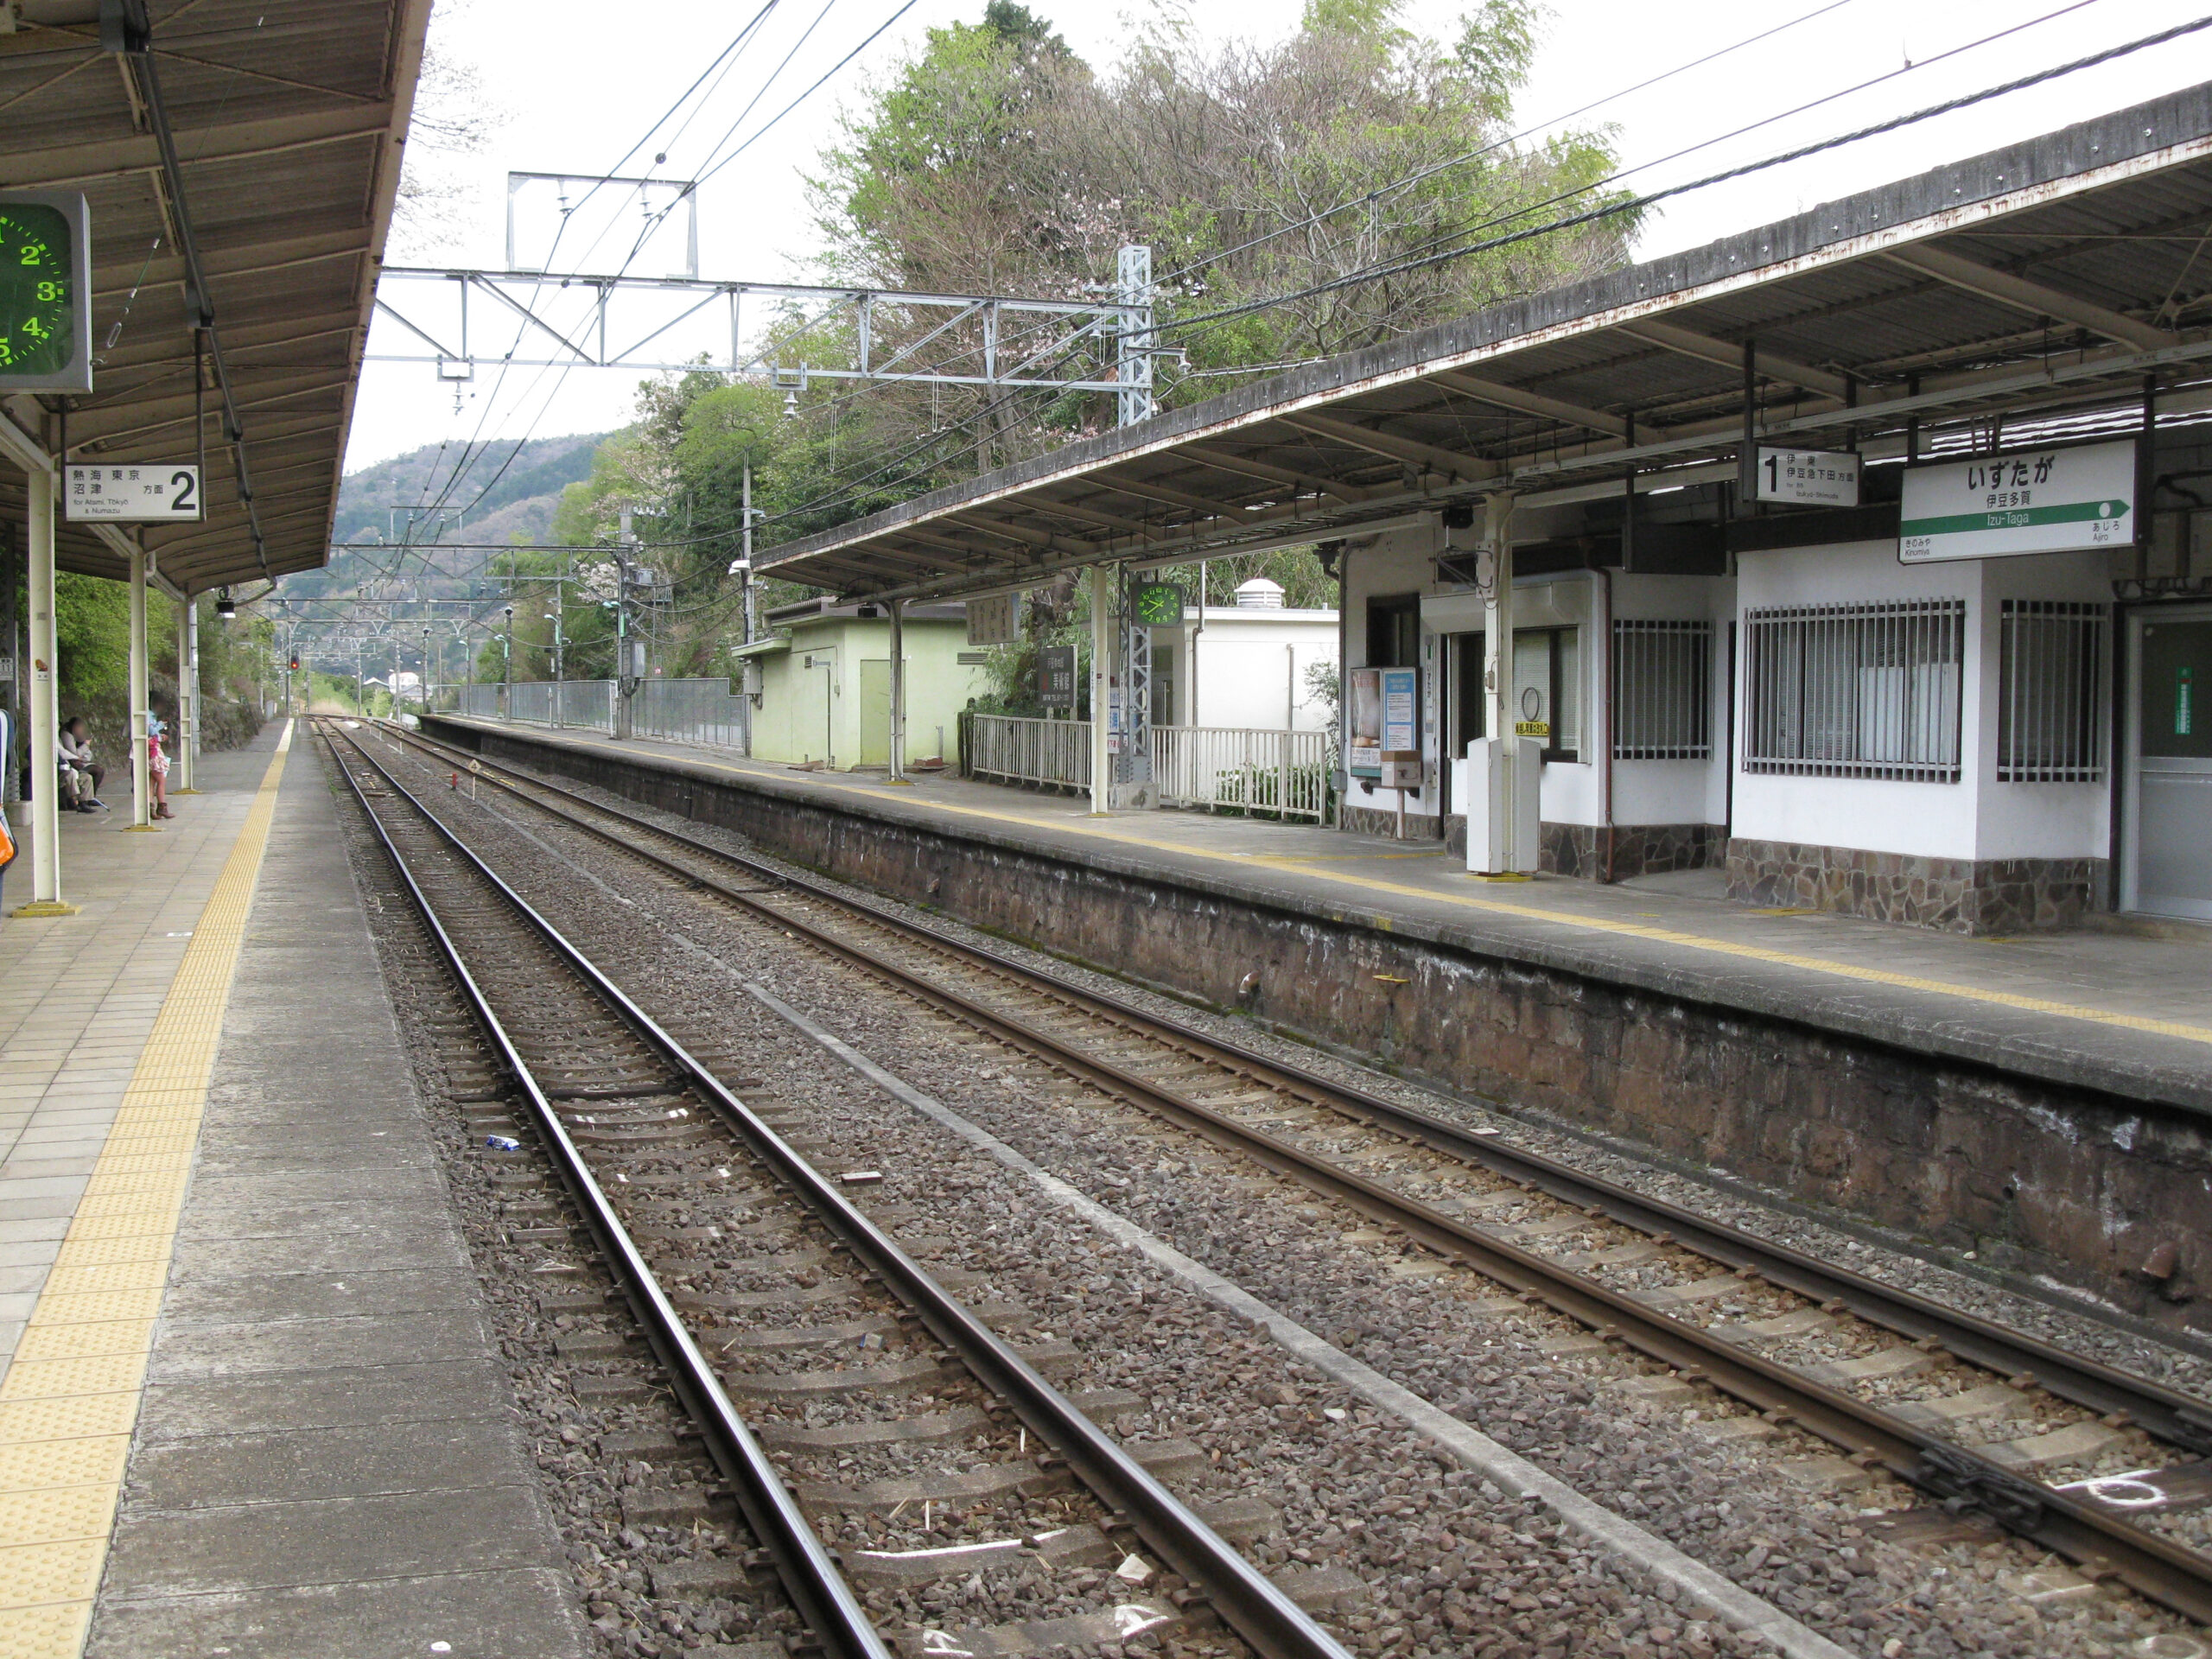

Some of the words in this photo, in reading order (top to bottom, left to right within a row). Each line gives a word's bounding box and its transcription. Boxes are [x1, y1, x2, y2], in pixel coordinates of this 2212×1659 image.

[21, 245, 40, 265] 2
[37, 282, 55, 301] 3
[22, 317, 42, 336] 4
[73, 469, 102, 481] 熱海
[111, 469, 140, 481] 東京
[1764, 454, 1777, 493] 1
[1967, 455, 2055, 490] いずたが
[73, 483, 102, 495] 沼津
[143, 485, 163, 495] 方面
[170, 471, 196, 511] 2
[1986, 490, 2031, 509] 伊豆多賀
[1987, 512, 2030, 526] Izu-Taga
[2092, 521, 2120, 532] あじろ
[1905, 537, 1931, 549] きのみや
[2093, 532, 2109, 542] Ajiro
[1904, 548, 1930, 557] Kinomiya
